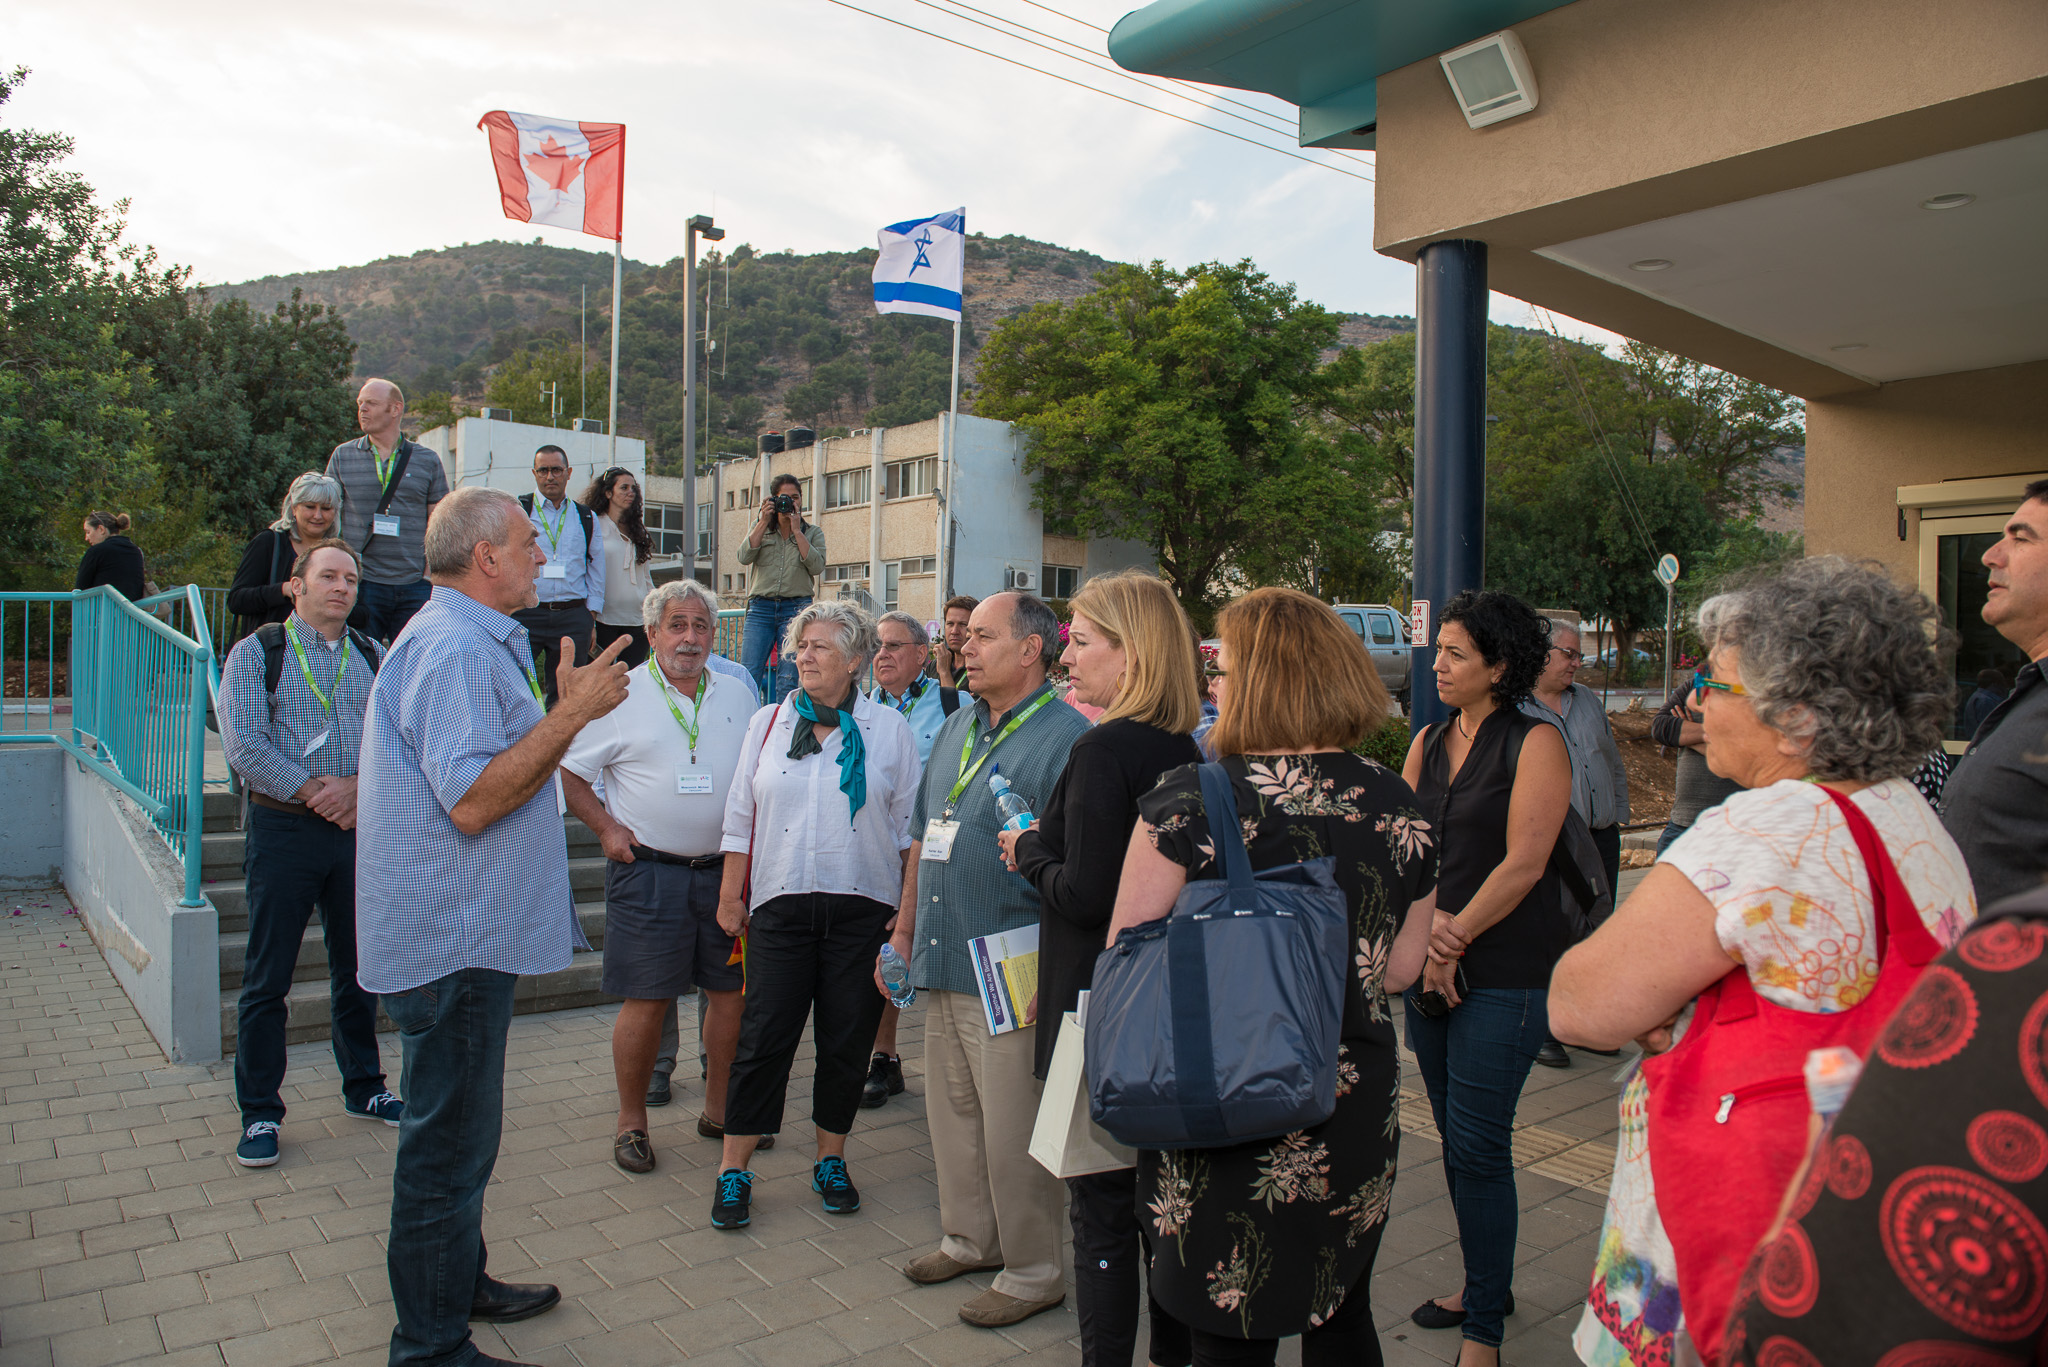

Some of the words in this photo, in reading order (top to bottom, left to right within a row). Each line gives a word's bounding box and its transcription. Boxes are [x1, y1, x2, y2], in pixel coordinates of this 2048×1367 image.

[982, 955, 991, 973] Better
[989, 984, 995, 993] We
[992, 994, 1001, 1017] Together
